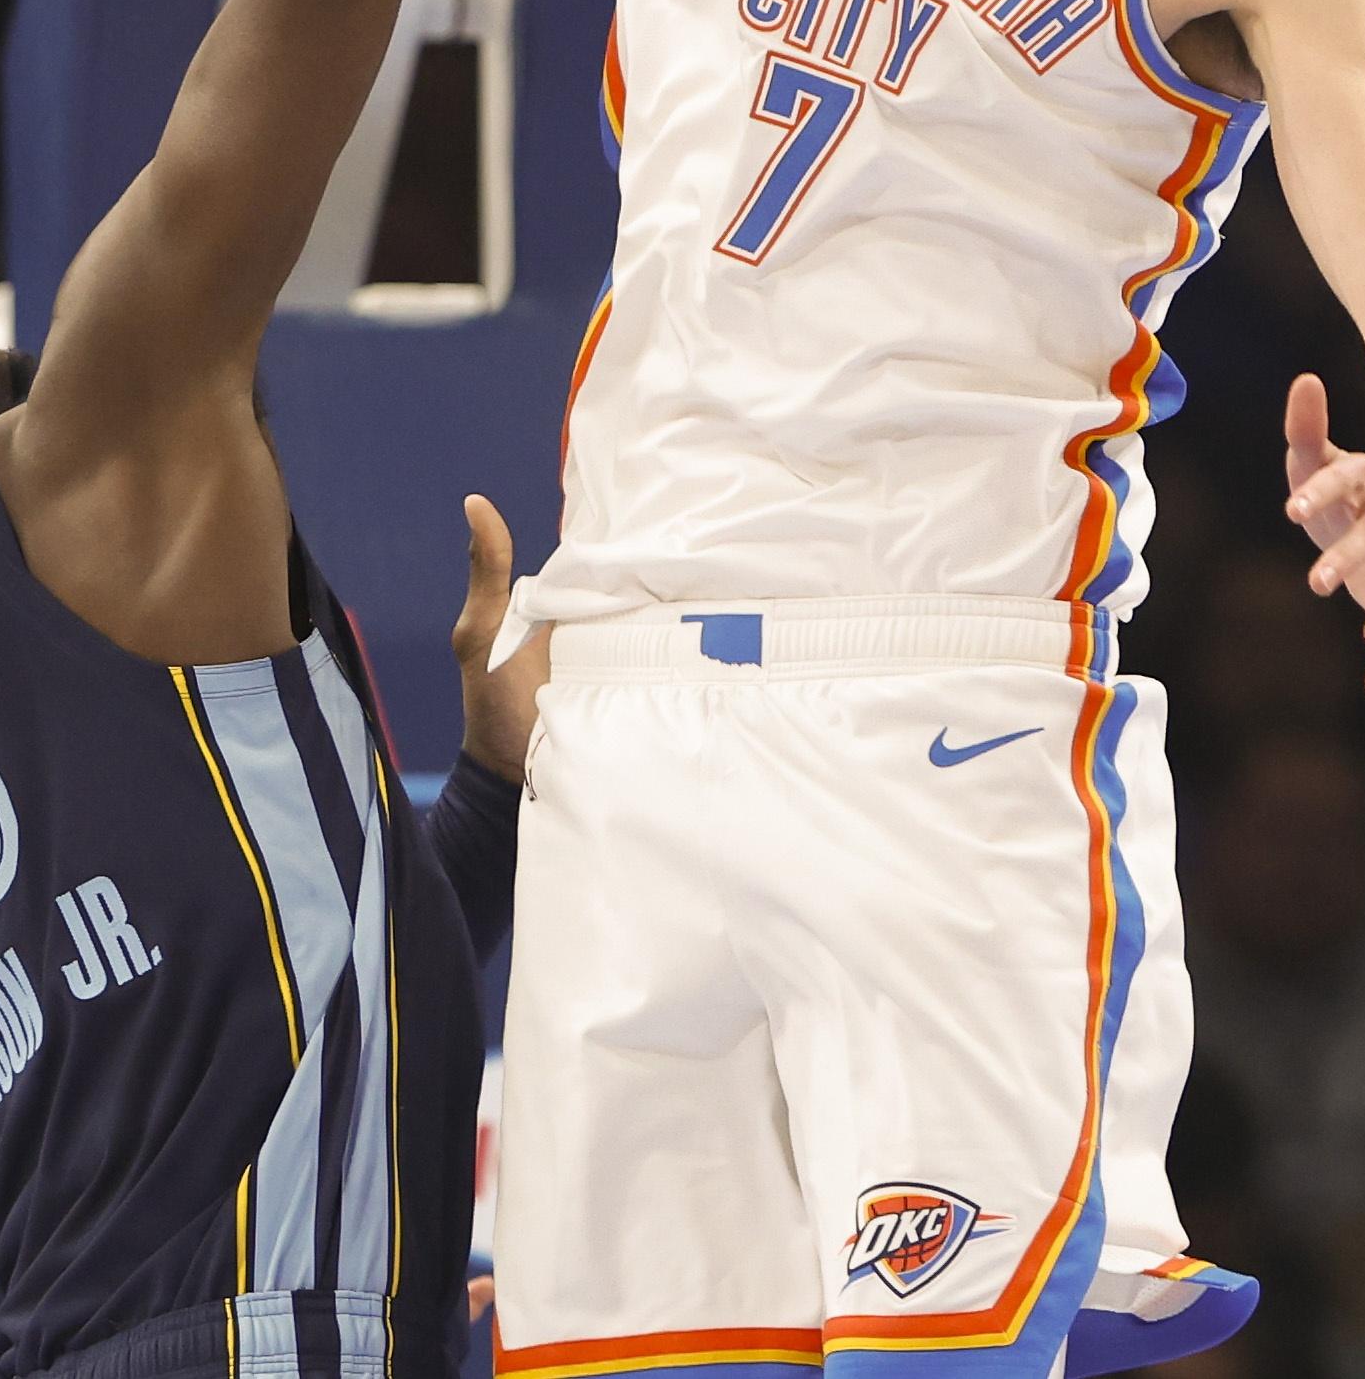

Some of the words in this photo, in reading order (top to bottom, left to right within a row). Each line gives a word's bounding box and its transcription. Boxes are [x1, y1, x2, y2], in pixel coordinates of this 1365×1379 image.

[712, 49, 867, 267] 7
[55, 875, 164, 1000] JR.
[848, 1205, 950, 1275] OKC
